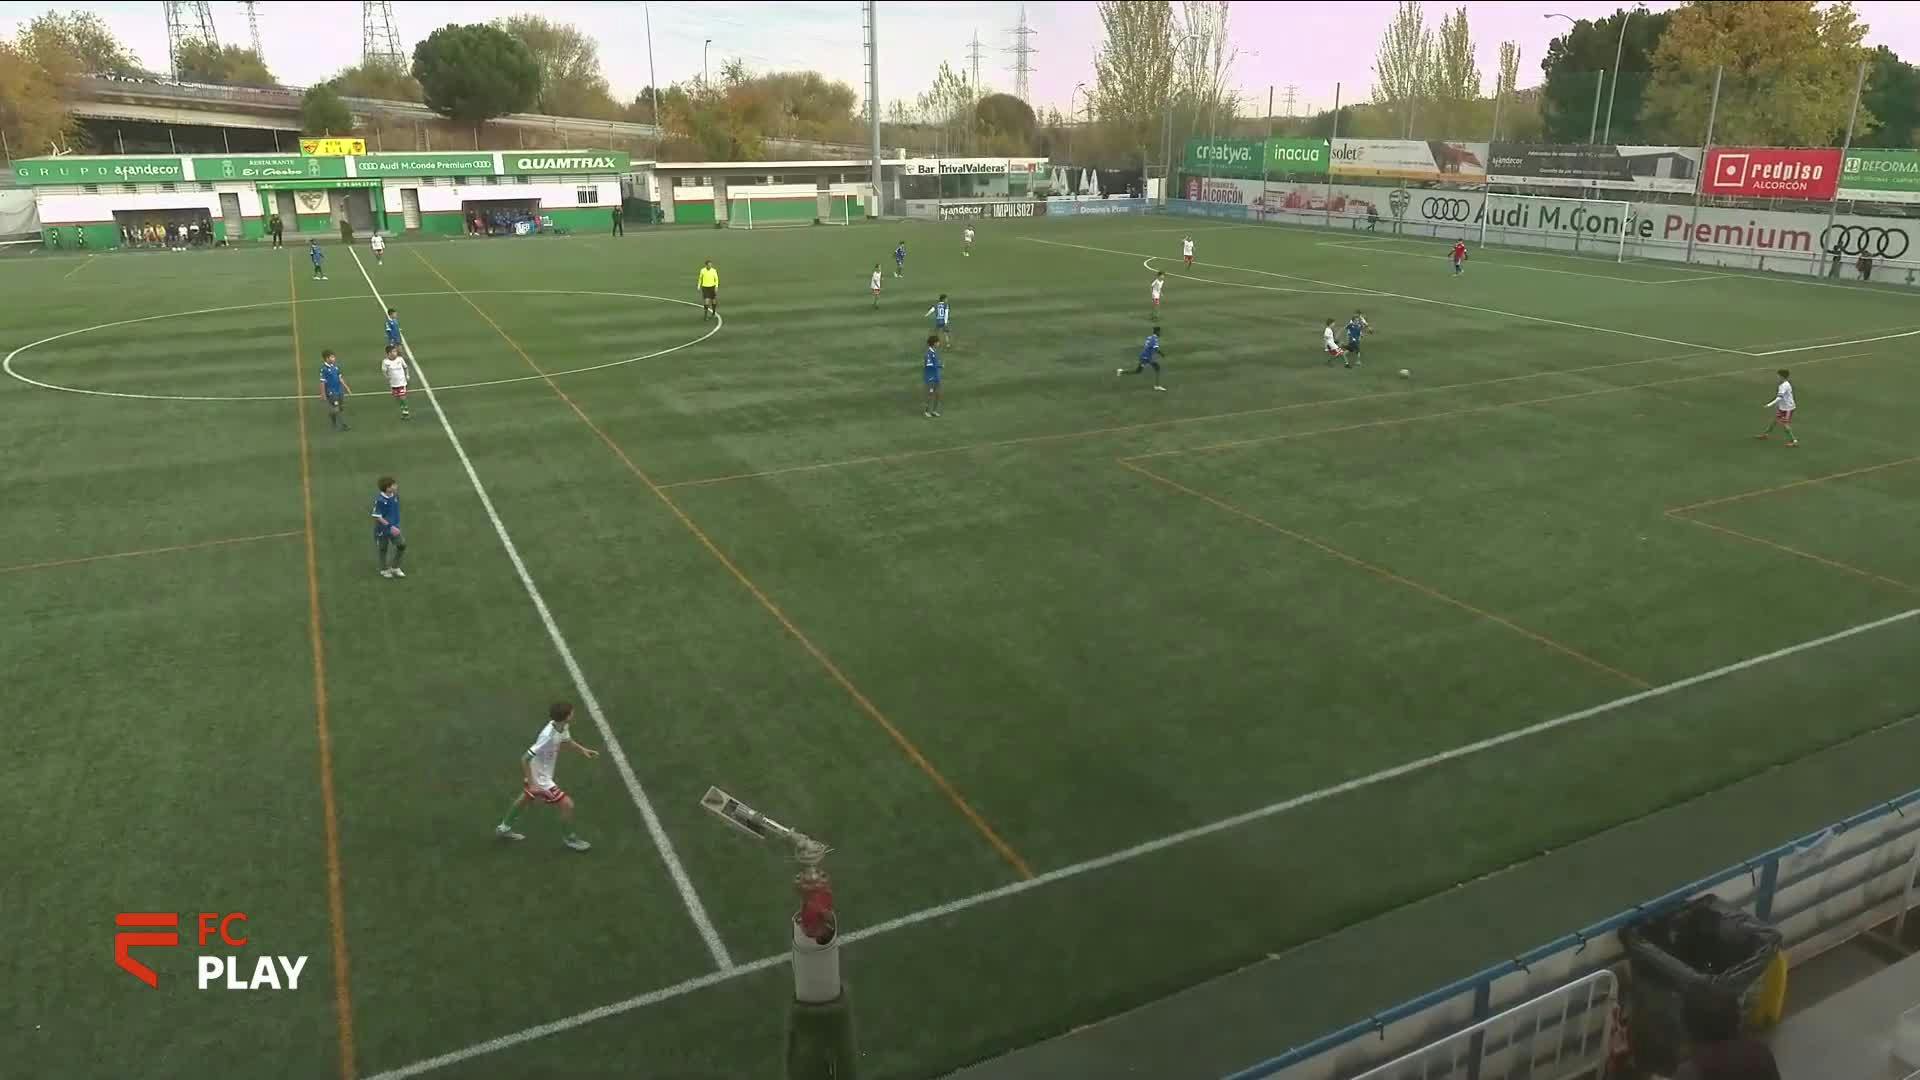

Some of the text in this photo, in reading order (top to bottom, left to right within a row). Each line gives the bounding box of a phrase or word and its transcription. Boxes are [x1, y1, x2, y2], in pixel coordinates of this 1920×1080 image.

[1274, 144, 1320, 162] inacua
[379, 159, 473, 171] Audi M.Conde Premium
[517, 157, 616, 170] QUAMTRAX
[918, 164, 936, 174] Bar
[940, 163, 1006, 174] TrivalValderas
[1751, 160, 1824, 181] redpiso
[114, 164, 179, 181] afandecor
[1753, 180, 1808, 191] ALCORCÓN
[940, 205, 983, 220] afandecor
[1473, 202, 1812, 252] Audi M.Conde Premium
[937, 307, 945, 317] 10
